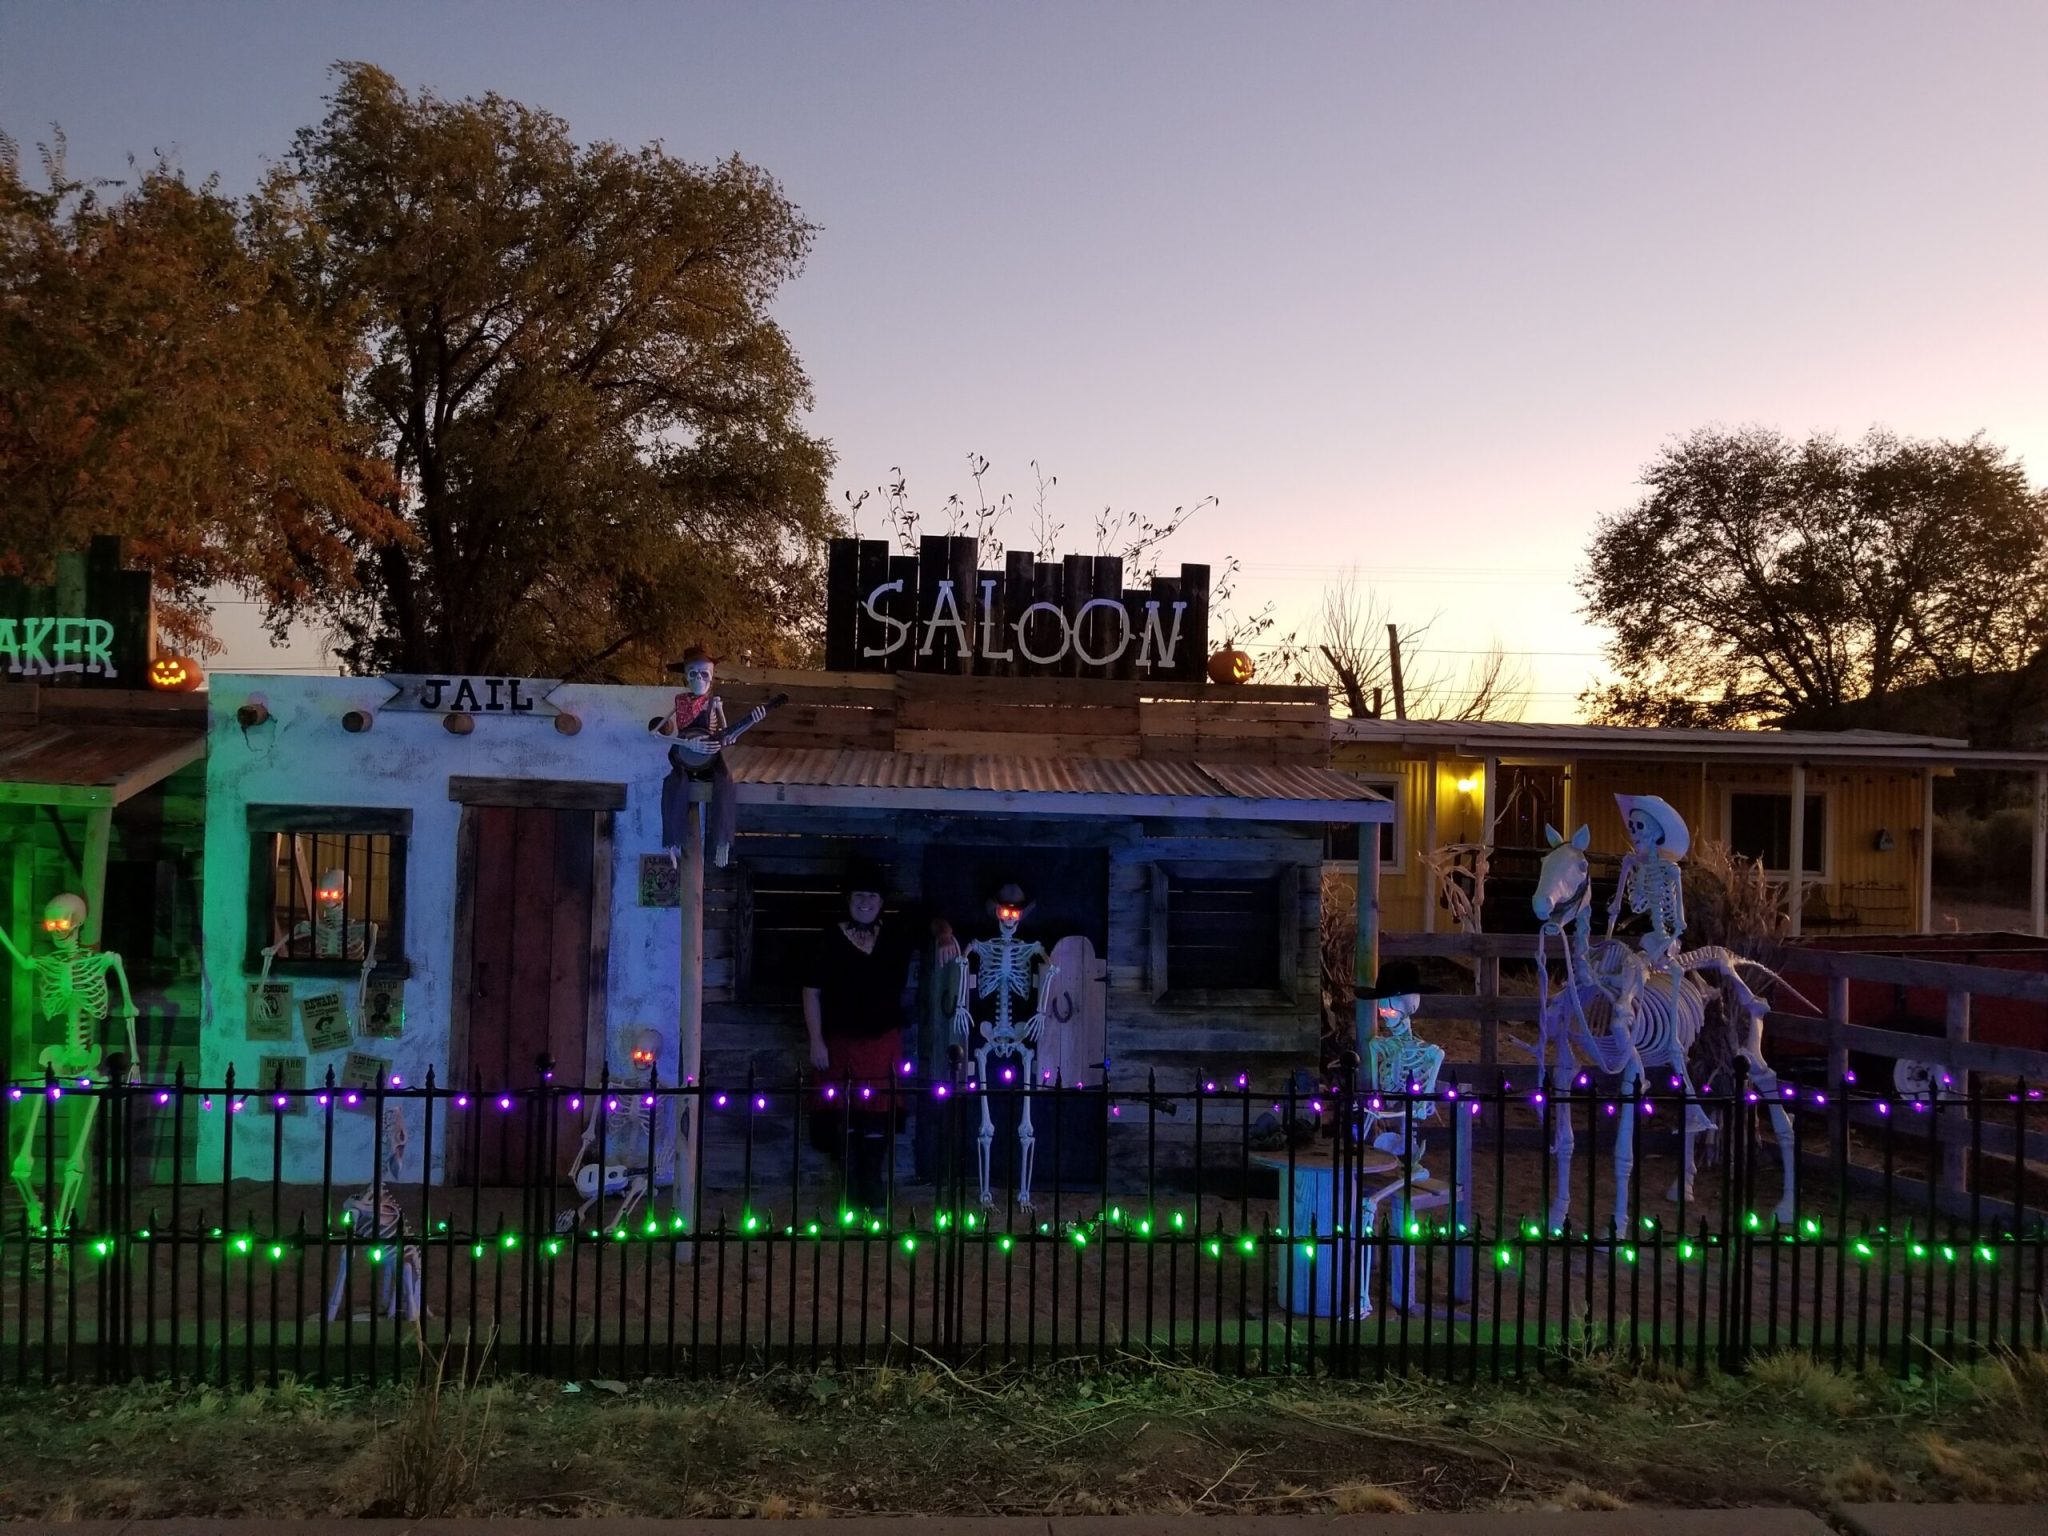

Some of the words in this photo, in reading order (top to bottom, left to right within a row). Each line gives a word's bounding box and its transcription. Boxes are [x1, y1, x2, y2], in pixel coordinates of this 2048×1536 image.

[860, 579, 1187, 668] SALOON
[419, 679, 533, 711] JAIL
[251, 984, 289, 993] WRNING
[304, 994, 339, 1010] REWARD
